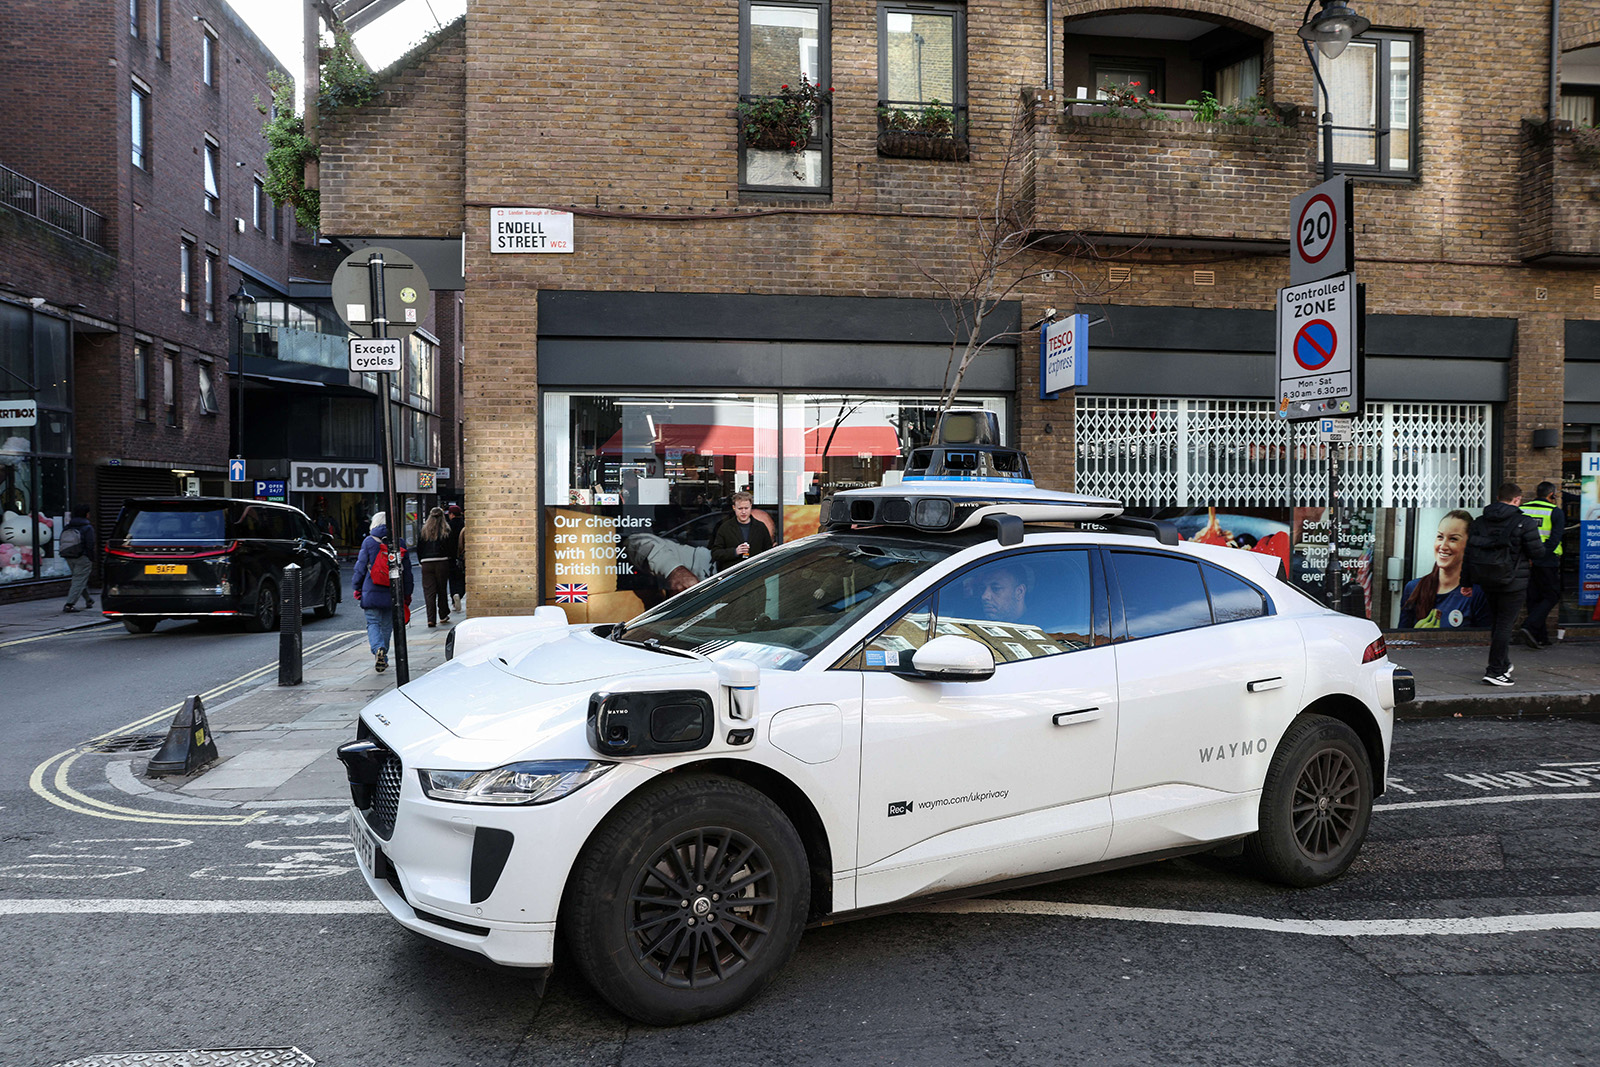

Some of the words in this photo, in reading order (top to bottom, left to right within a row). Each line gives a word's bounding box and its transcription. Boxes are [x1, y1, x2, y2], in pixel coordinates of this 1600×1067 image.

[498, 221, 544, 234] ENDELL
[1303, 211, 1331, 247] 20
[498, 235, 547, 248] STREET
[550, 240, 567, 248] WC2
[1286, 281, 1345, 303] Controlled
[1294, 298, 1336, 318] ZONE
[1048, 330, 1073, 351] TESCO
[354, 344, 396, 355] Except
[356, 356, 394, 367] cycles
[1048, 355, 1073, 377] express
[1319, 378, 1332, 386] Sat
[1283, 391, 1300, 399] 8.30
[1317, 387, 1335, 395] 6.30
[1336, 386, 1348, 394] pm
[296, 467, 369, 489] ROKIT
[256, 481, 266, 495] P
[554, 515, 582, 528] Our
[585, 515, 652, 528] cheddars
[1080, 522, 1107, 530] Fres
[554, 533, 577, 544] are
[582, 531, 622, 544] made
[1338, 532, 1376, 543] Street's
[554, 547, 585, 560] with
[589, 546, 628, 560] 100%
[555, 562, 600, 576] British
[605, 562, 638, 575] milk.
[1301, 560, 1309, 569] a
[1310, 558, 1328, 569] littl
[1301, 573, 1326, 583] ever
[1199, 738, 1268, 763] WAYMO
[889, 805, 905, 815] Rec
[918, 789, 1009, 811] waymo.com/ukprivacy
